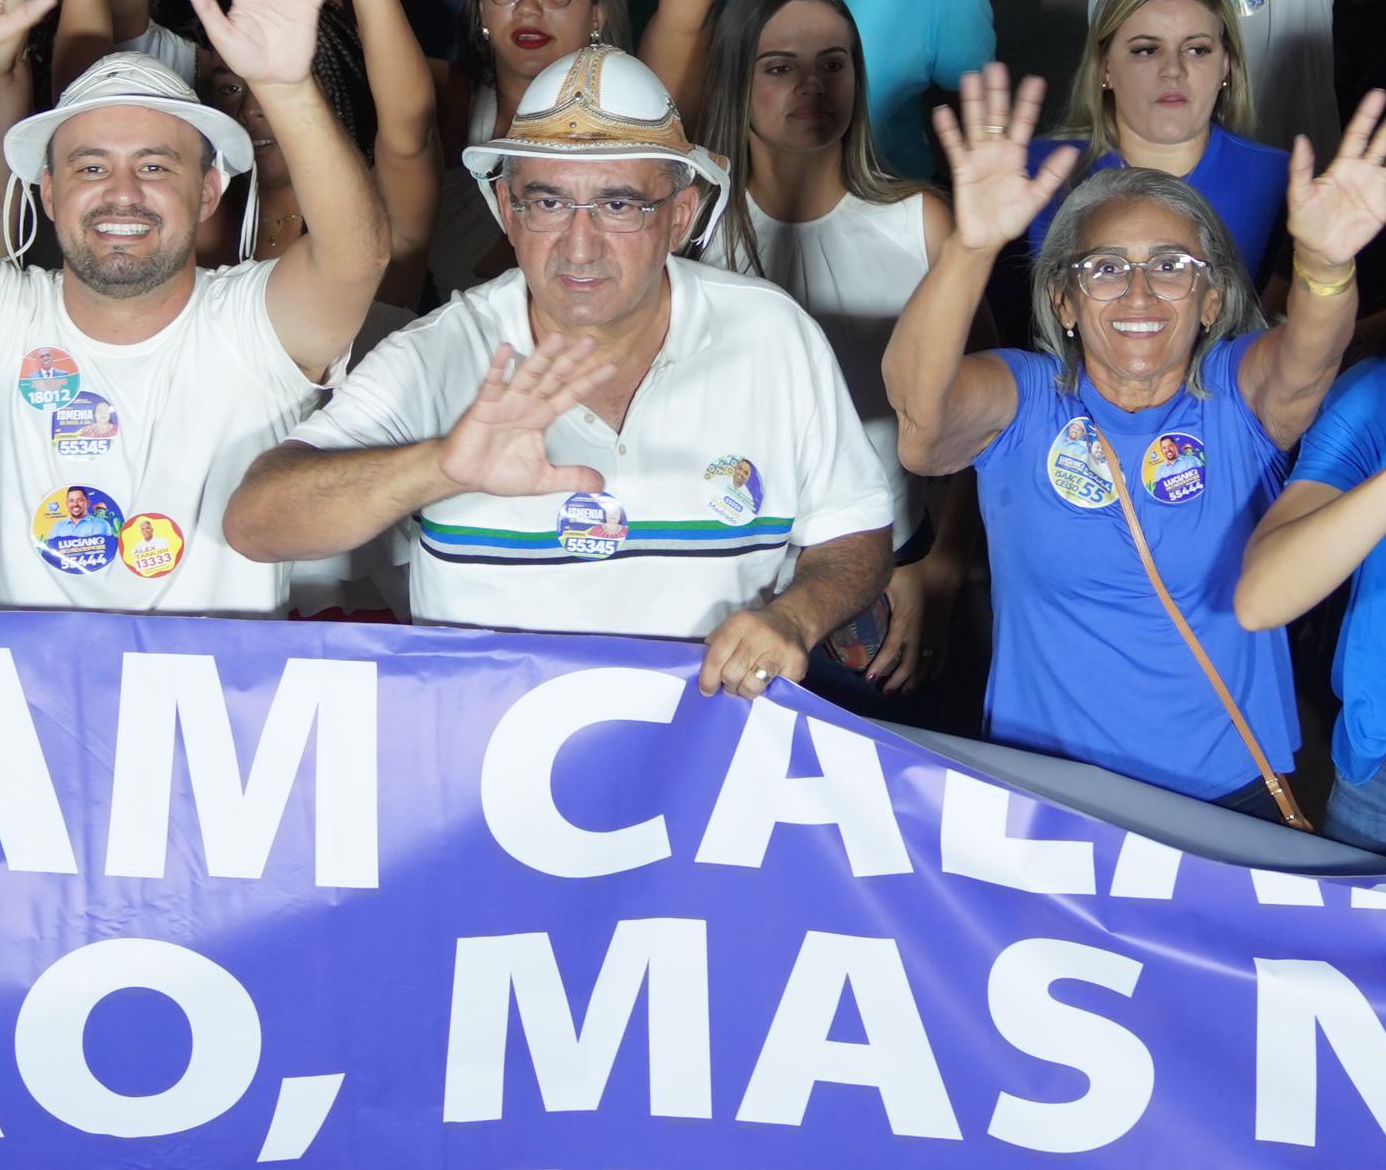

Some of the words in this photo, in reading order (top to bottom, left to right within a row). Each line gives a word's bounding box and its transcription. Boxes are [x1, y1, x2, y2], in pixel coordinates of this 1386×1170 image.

[28, 389, 71, 403] 18012
[60, 439, 108, 454] 55345
[1055, 479, 1079, 492] CELSO
[1163, 468, 1199, 487] LUCIANO
[1078, 482, 1105, 504] 55
[1168, 482, 1204, 501] 55444
[58, 537, 105, 549] LUCIANO
[566, 538, 615, 555] 55345
[61, 554, 108, 570] 55444
[136, 553, 172, 570] 13333
[442, 917, 1155, 1154] MAS
